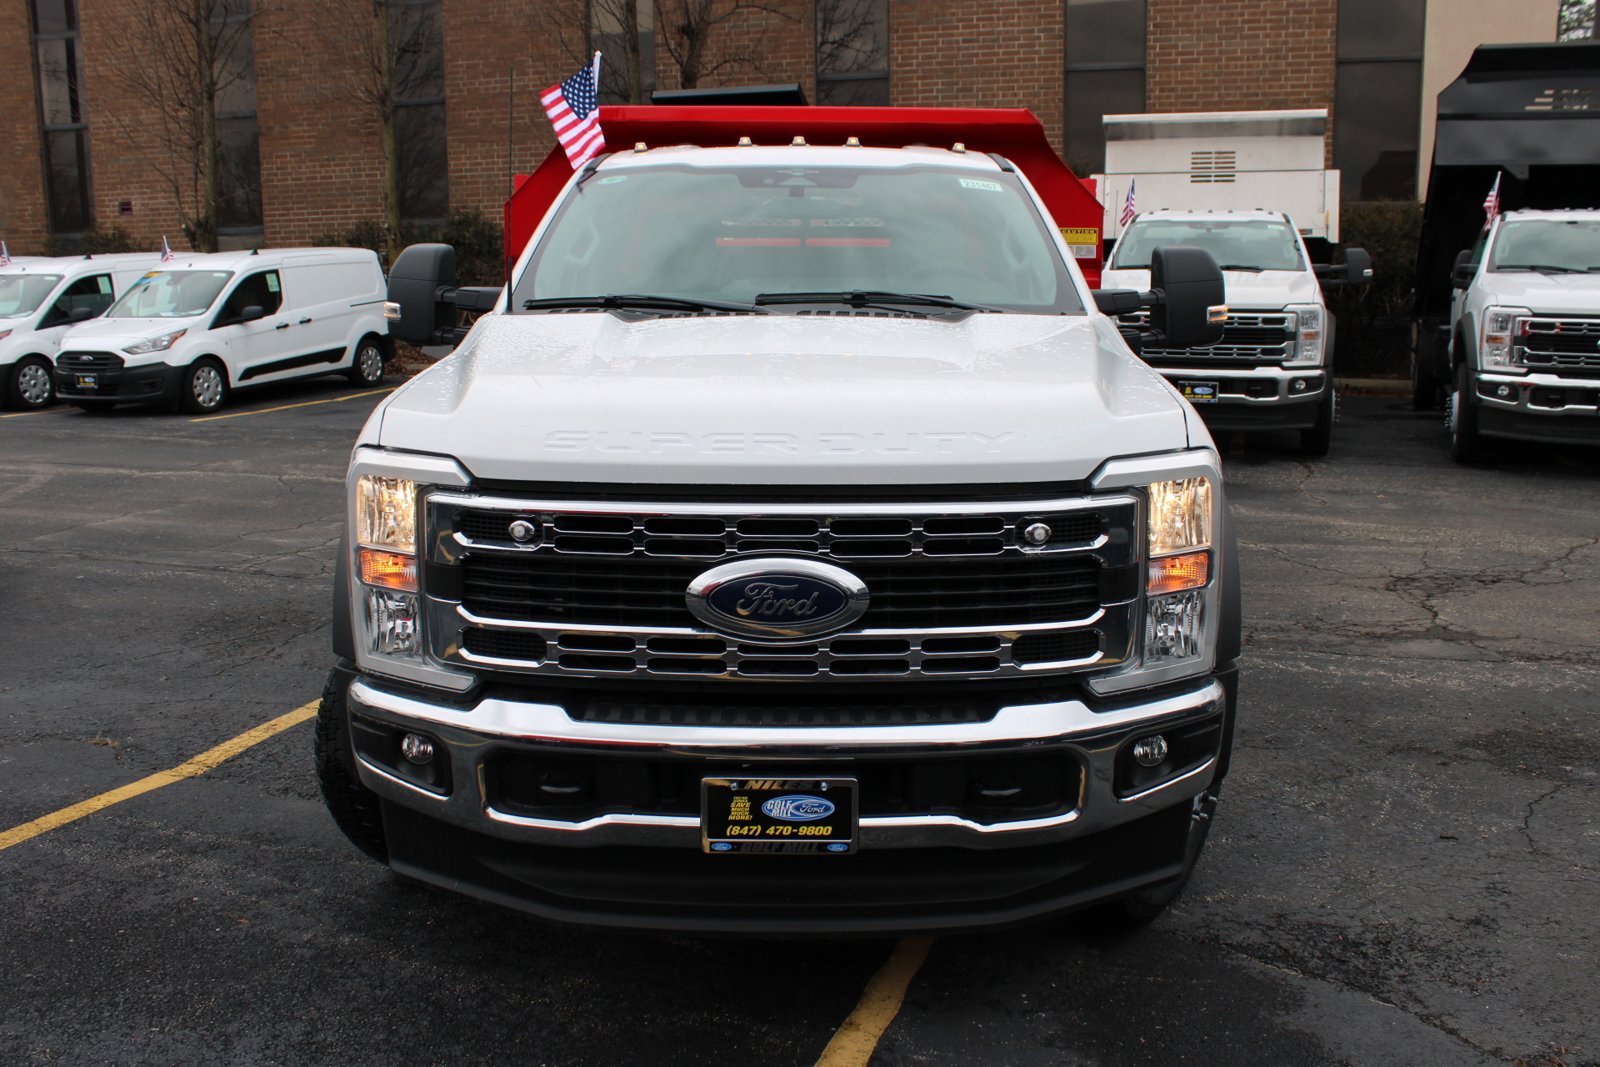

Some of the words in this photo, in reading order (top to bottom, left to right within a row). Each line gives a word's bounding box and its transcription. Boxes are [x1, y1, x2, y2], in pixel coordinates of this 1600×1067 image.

[544, 431, 799, 454] SUPER
[818, 431, 1013, 454] DUTY
[736, 582, 819, 616] Ford
[743, 780, 814, 790] NILES
[767, 800, 792, 809] GOLF
[800, 803, 825, 813] Ford
[771, 808, 792, 817] MILL
[726, 825, 761, 836] (847)
[766, 825, 832, 836] 470-9800
